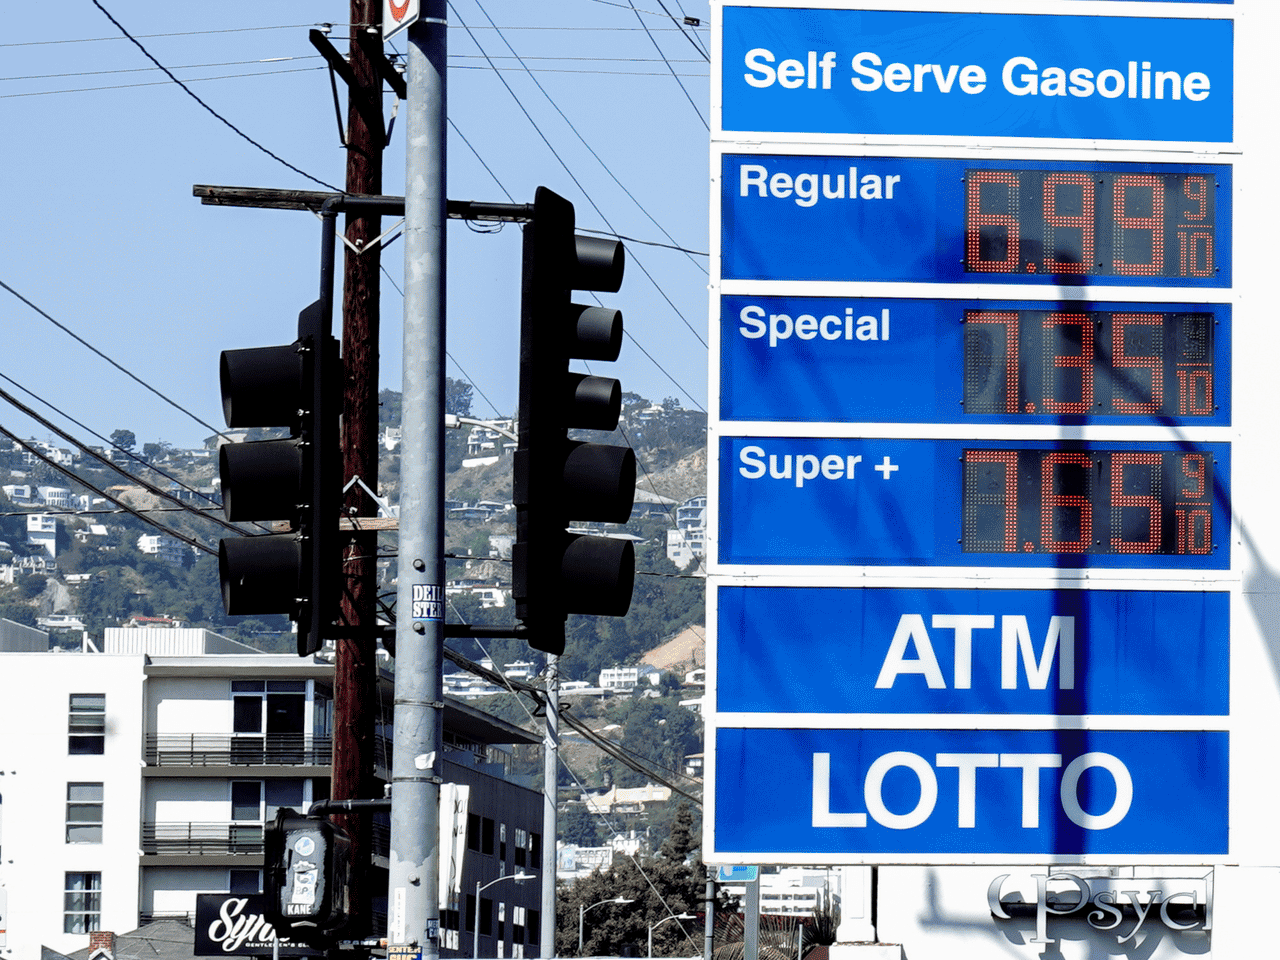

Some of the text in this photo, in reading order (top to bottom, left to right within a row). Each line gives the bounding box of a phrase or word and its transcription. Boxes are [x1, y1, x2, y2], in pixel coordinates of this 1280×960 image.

[743, 48, 1211, 101] Self Serve Gasoline
[739, 165, 901, 208] Regular
[739, 305, 890, 348] Special
[738, 446, 862, 488] Super
[874, 613, 1076, 690] ATM
[811, 751, 1134, 830] LOTTO
[287, 904, 312, 916] KANE
